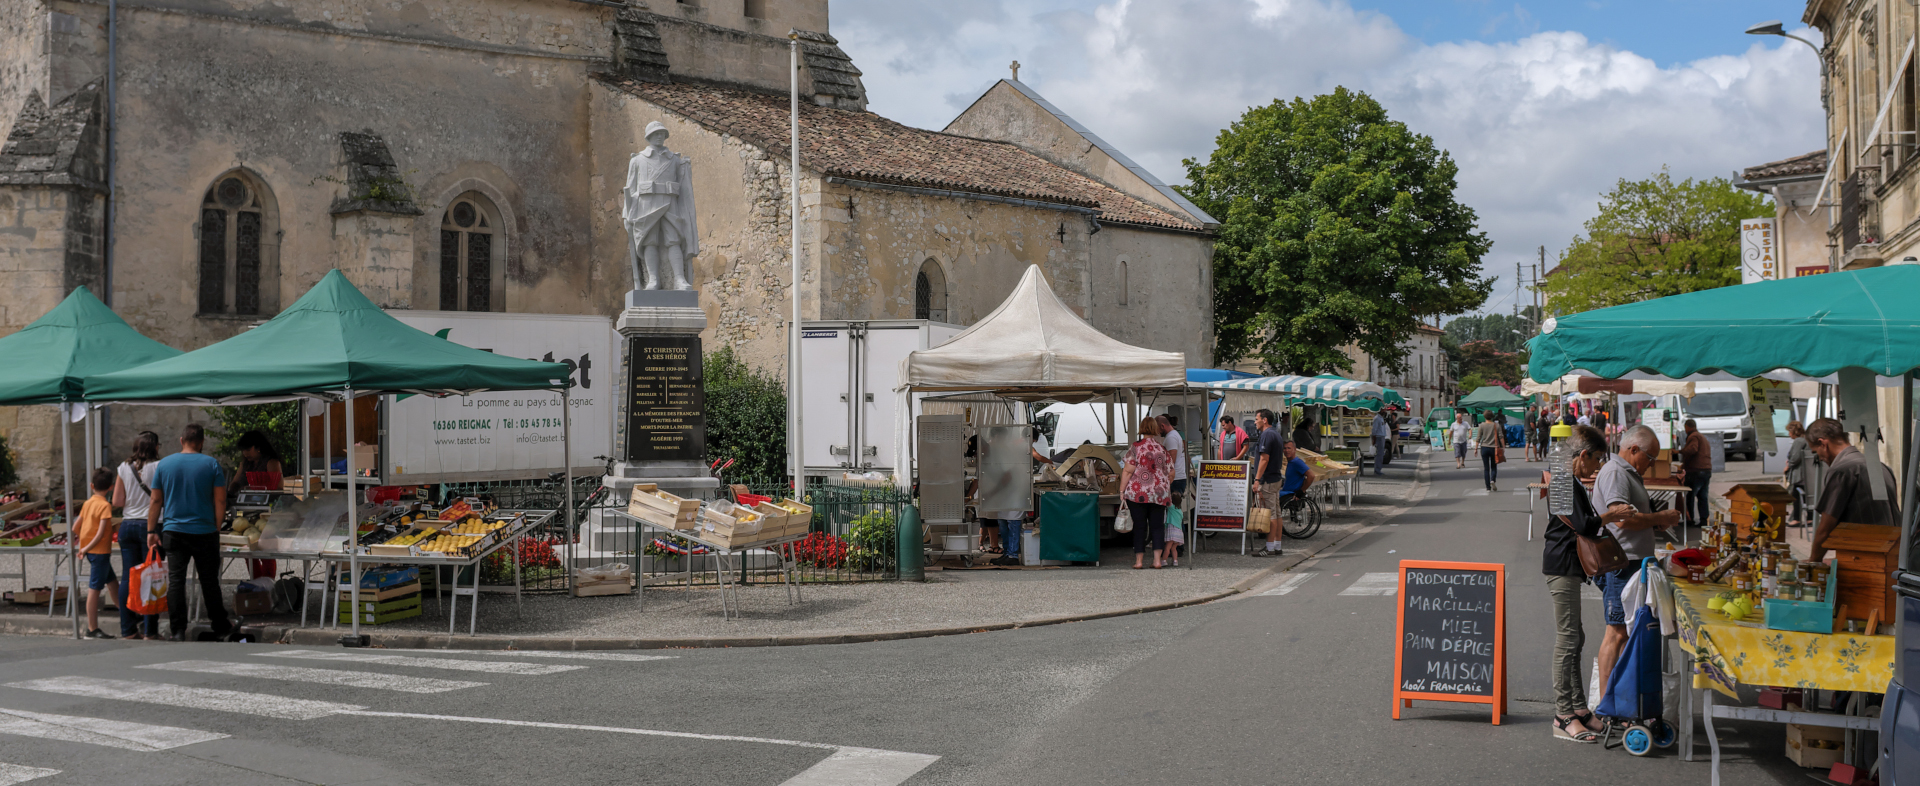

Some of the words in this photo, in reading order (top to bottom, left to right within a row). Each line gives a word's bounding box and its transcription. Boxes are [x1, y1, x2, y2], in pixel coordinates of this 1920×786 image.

[1743, 223, 1771, 231] BAR
[1761, 223, 1773, 280] RESTAUR
[664, 352, 687, 360] HÉROS
[462, 396, 473, 407] La
[477, 399, 510, 409] pomme
[527, 399, 547, 409] pays
[549, 394, 561, 407] du
[566, 397, 594, 409] ognac
[432, 420, 456, 430] 16360
[458, 419, 491, 430] REIGNAC
[503, 418, 513, 429] Tél
[520, 419, 529, 429] 05
[531, 419, 540, 428] 45
[542, 419, 550, 428] 78
[434, 434, 490, 445] www.tastet.biz
[516, 432, 565, 444] info@tastet.b
[1406, 571, 1496, 588] PRODUCTEUR
[1409, 595, 1494, 614] MARCILLAC
[1441, 615, 1483, 635] MIEL
[1405, 629, 1436, 650] PAIN
[1426, 659, 1494, 684] MAISON
[1401, 678, 1426, 692] 100%
